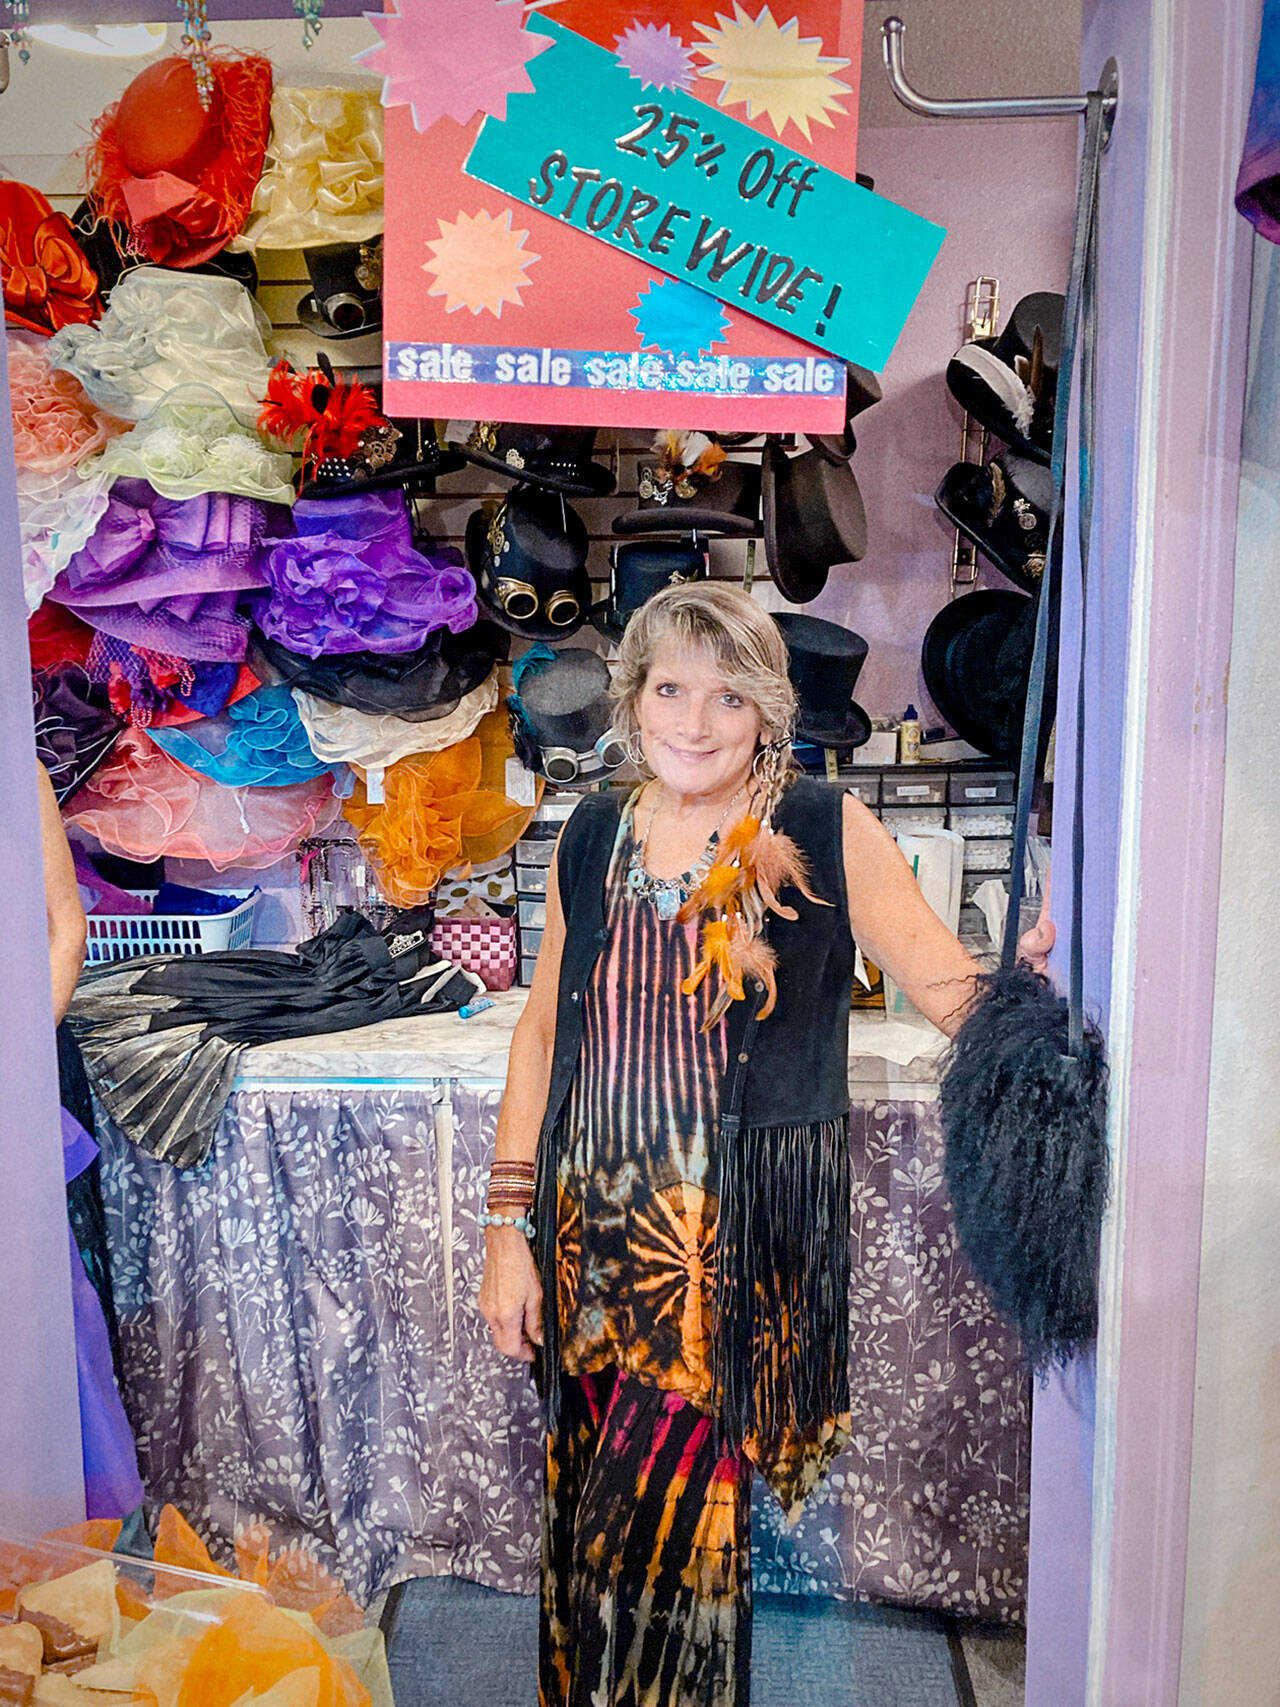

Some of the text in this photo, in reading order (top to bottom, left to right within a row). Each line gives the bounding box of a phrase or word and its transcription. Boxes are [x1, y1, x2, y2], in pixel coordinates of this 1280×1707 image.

[615, 102, 819, 217] 25% Off
[397, 343, 836, 393] sale sale sale sale sale
